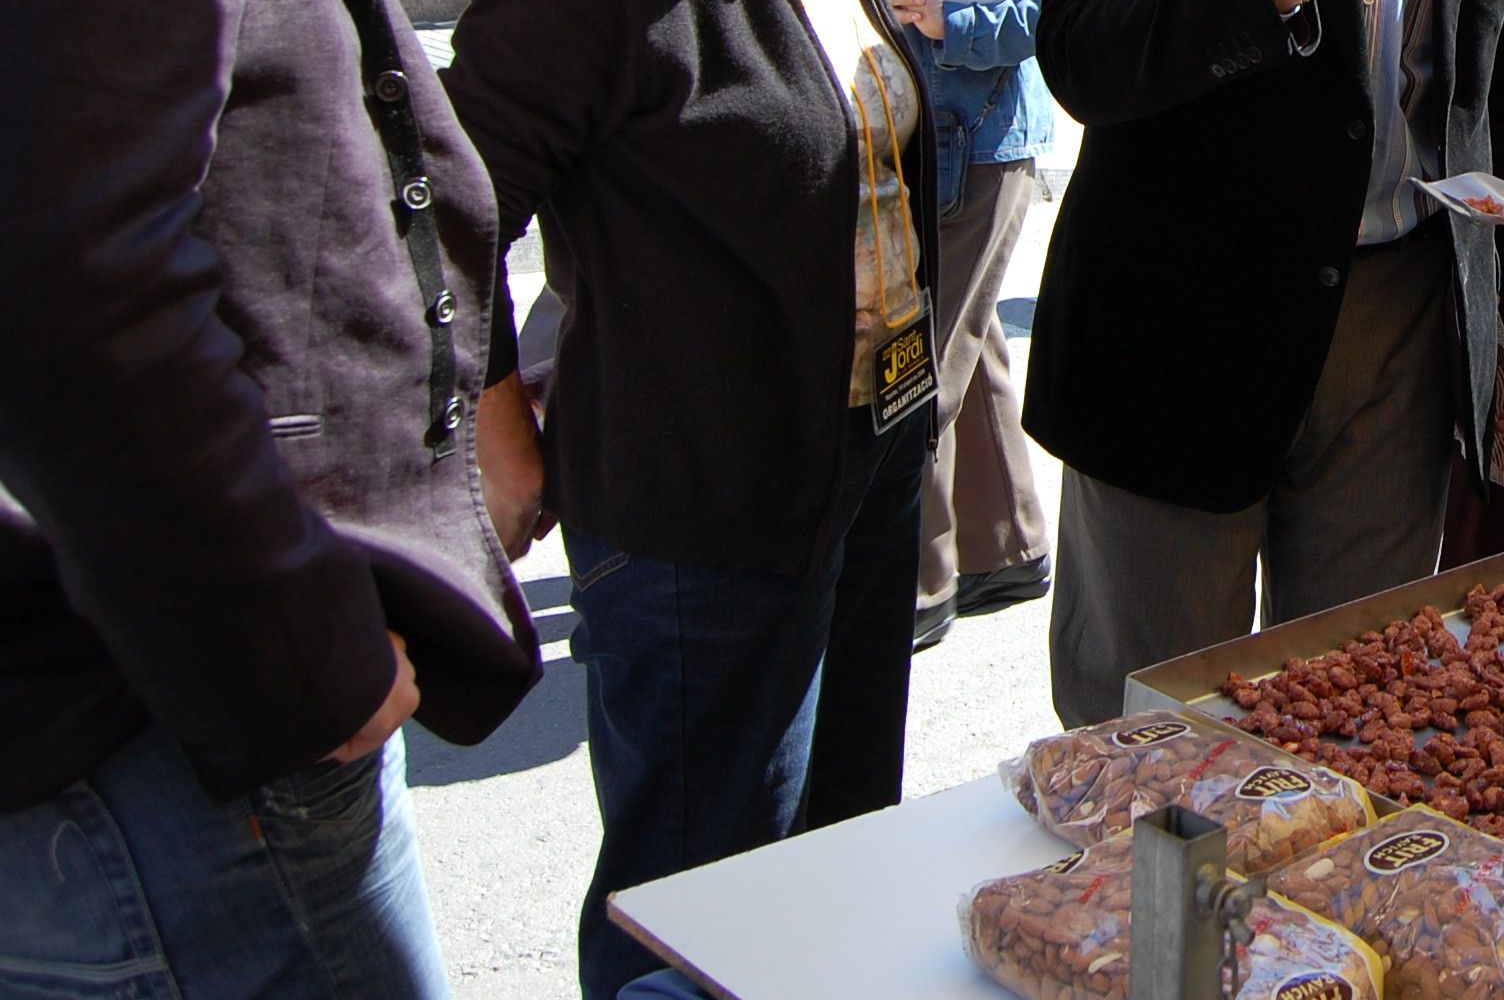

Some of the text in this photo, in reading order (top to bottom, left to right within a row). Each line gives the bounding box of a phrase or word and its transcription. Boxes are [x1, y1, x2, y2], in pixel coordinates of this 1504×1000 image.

[884, 332, 924, 384] Jordi
[1260, 772, 1310, 797] FRIT
[1372, 833, 1422, 860] RAVICH
[1386, 836, 1445, 868] FRIT
[1279, 973, 1337, 1000] RAVICH
